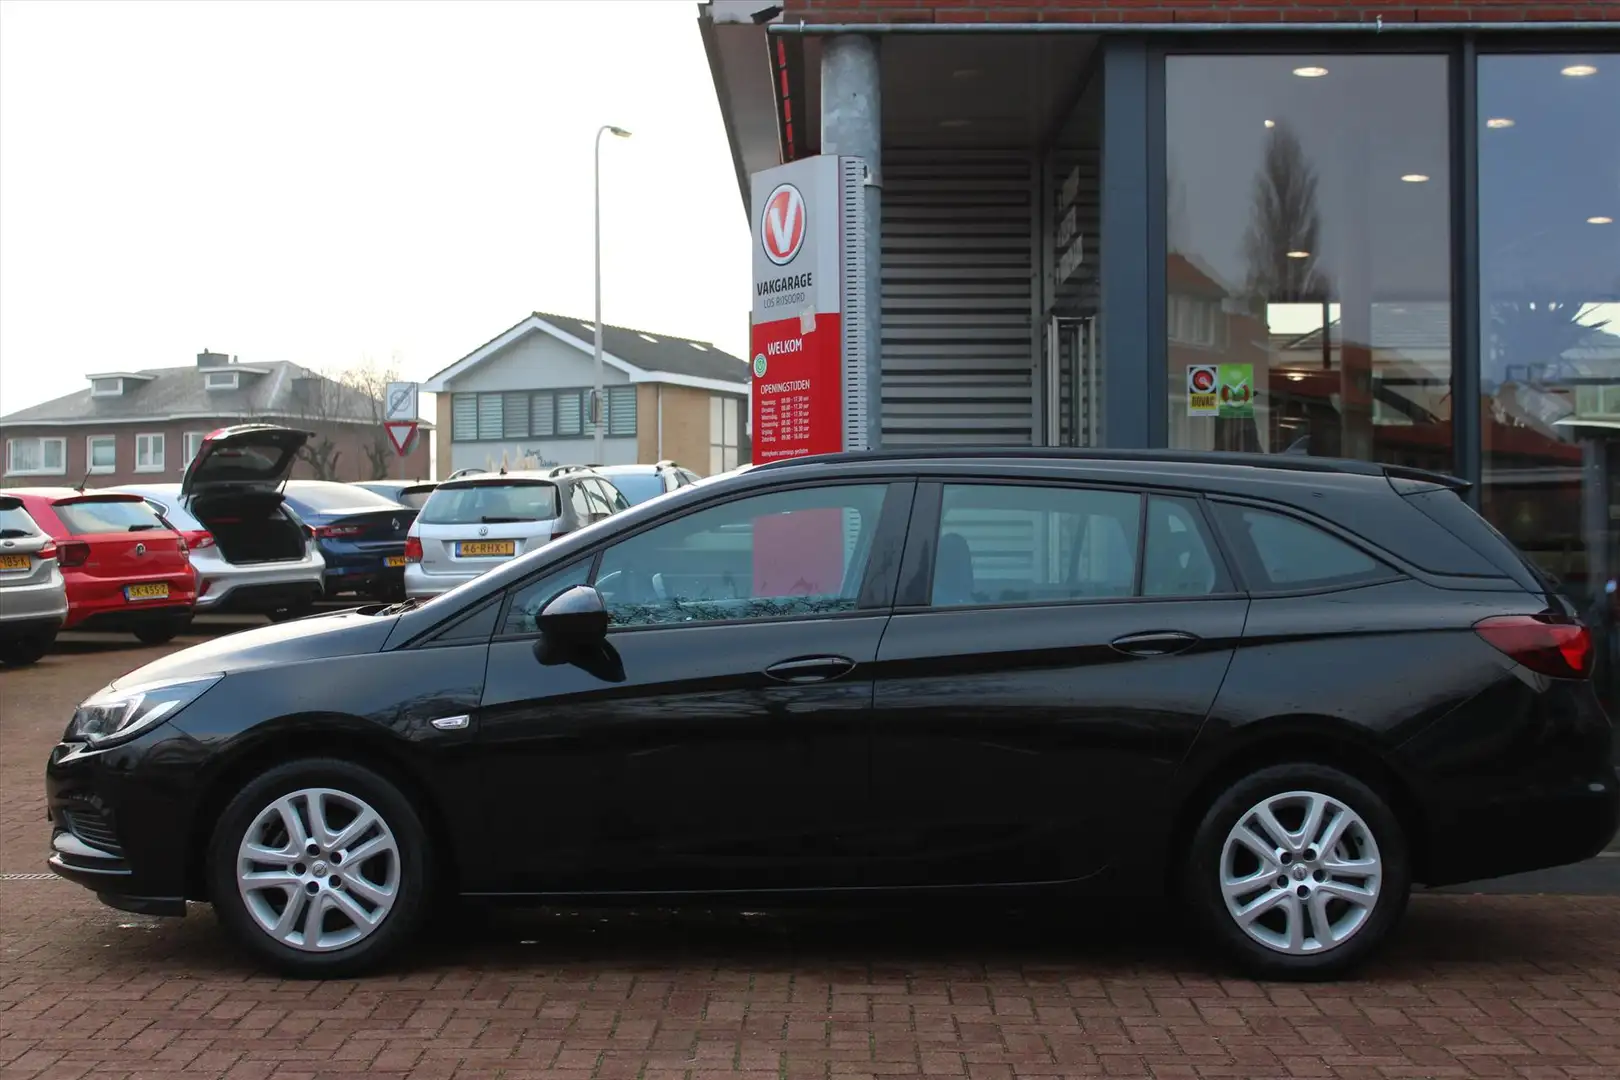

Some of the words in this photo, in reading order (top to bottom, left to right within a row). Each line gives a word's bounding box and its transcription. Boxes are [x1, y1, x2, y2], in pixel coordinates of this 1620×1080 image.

[757, 272, 812, 296] VAKGARAGE
[764, 298, 775, 308] LOS
[767, 338, 803, 355] WELKOM
[463, 543, 510, 553] 46-RHX-1
